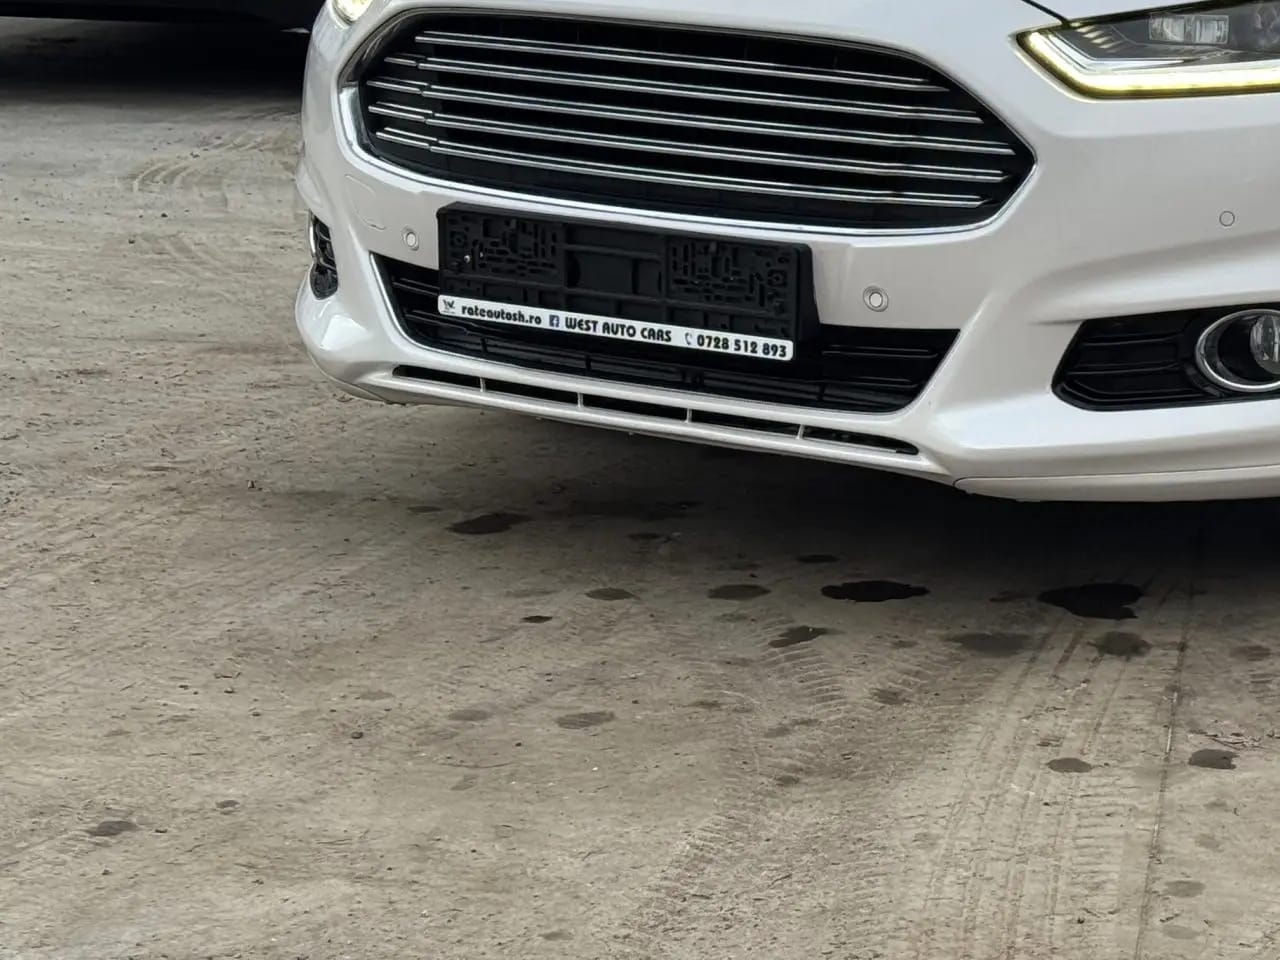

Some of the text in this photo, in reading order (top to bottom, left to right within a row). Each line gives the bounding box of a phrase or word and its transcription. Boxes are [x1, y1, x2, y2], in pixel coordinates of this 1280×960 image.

[461, 305, 542, 325] rateautosh.ro
[565, 316, 598, 333] WEST
[602, 321, 637, 338] AUTO
[640, 327, 672, 342] CARS
[697, 334, 730, 350] 0728
[734, 338, 758, 354] 512
[762, 342, 787, 358] 893
